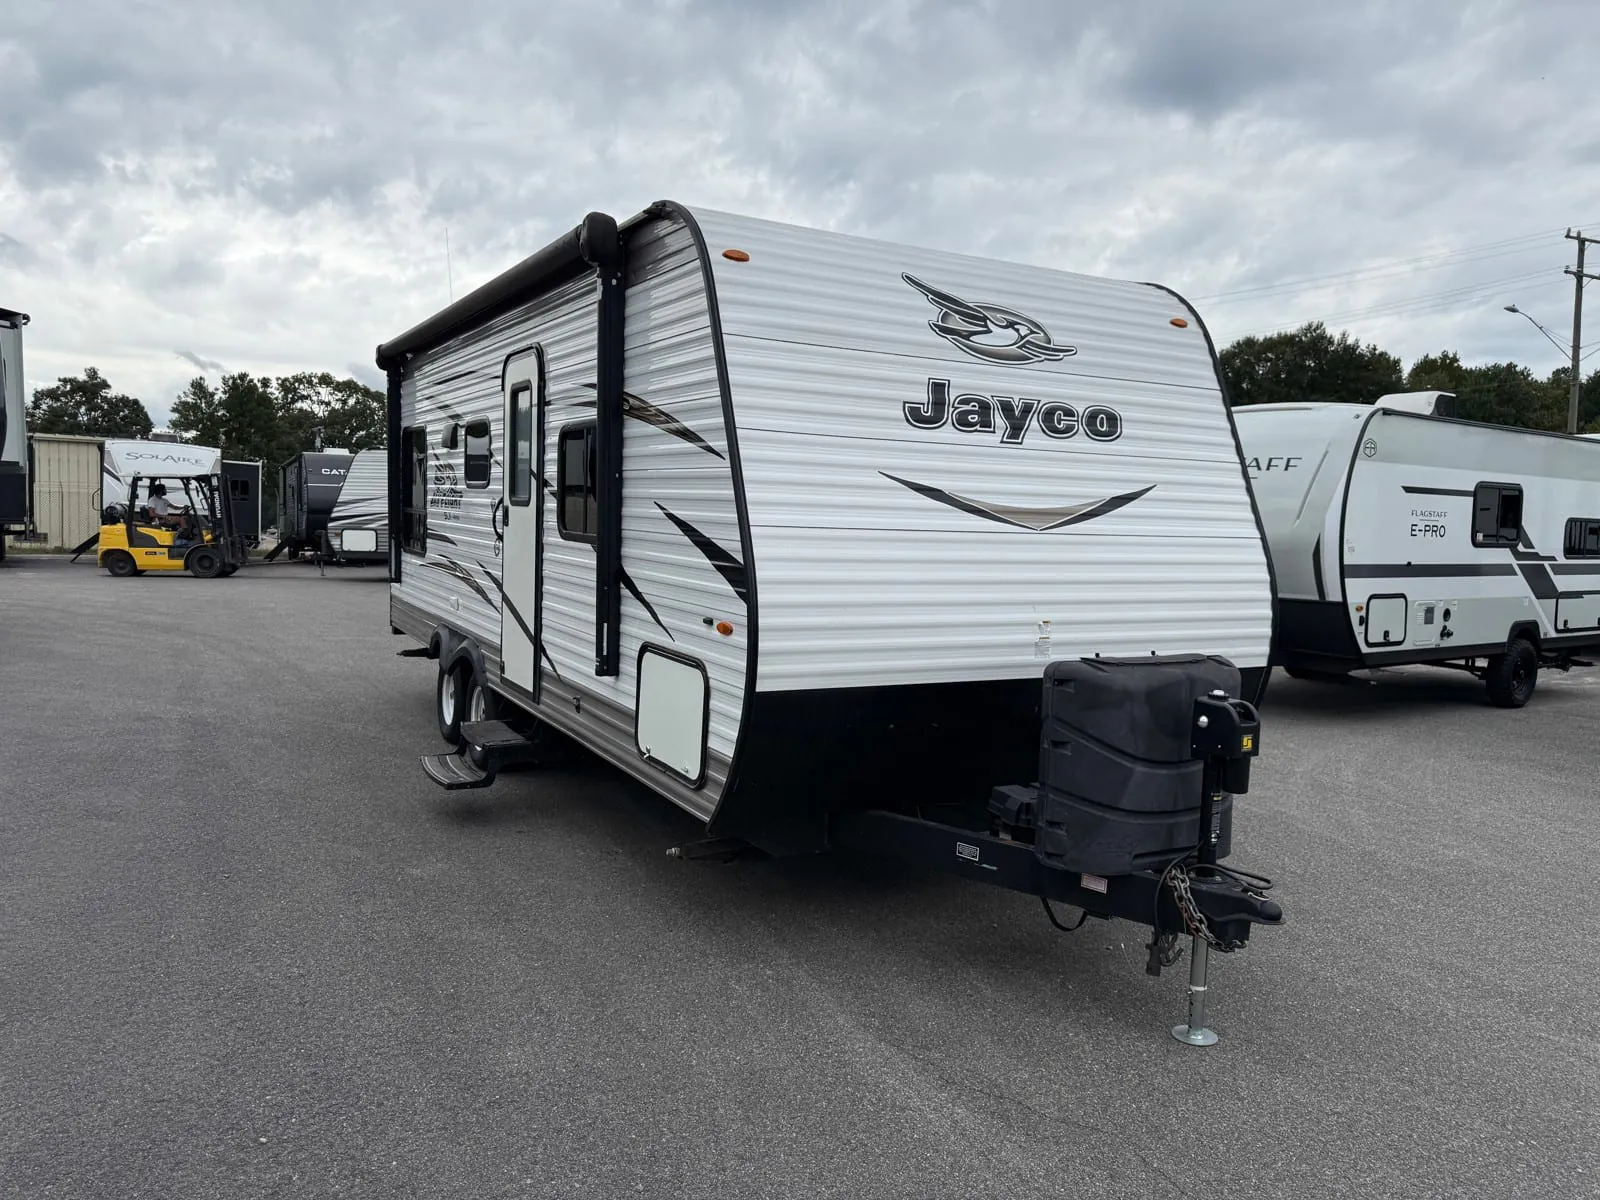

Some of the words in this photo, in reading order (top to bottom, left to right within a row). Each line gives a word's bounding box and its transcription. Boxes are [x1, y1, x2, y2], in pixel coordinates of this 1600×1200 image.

[903, 377, 1122, 444] Jayco
[125, 452, 206, 466] SOLAIRE
[1246, 457, 1302, 471] AFF
[1411, 509, 1448, 518] FLAGSTAFF
[1410, 524, 1446, 538] E-PRO
